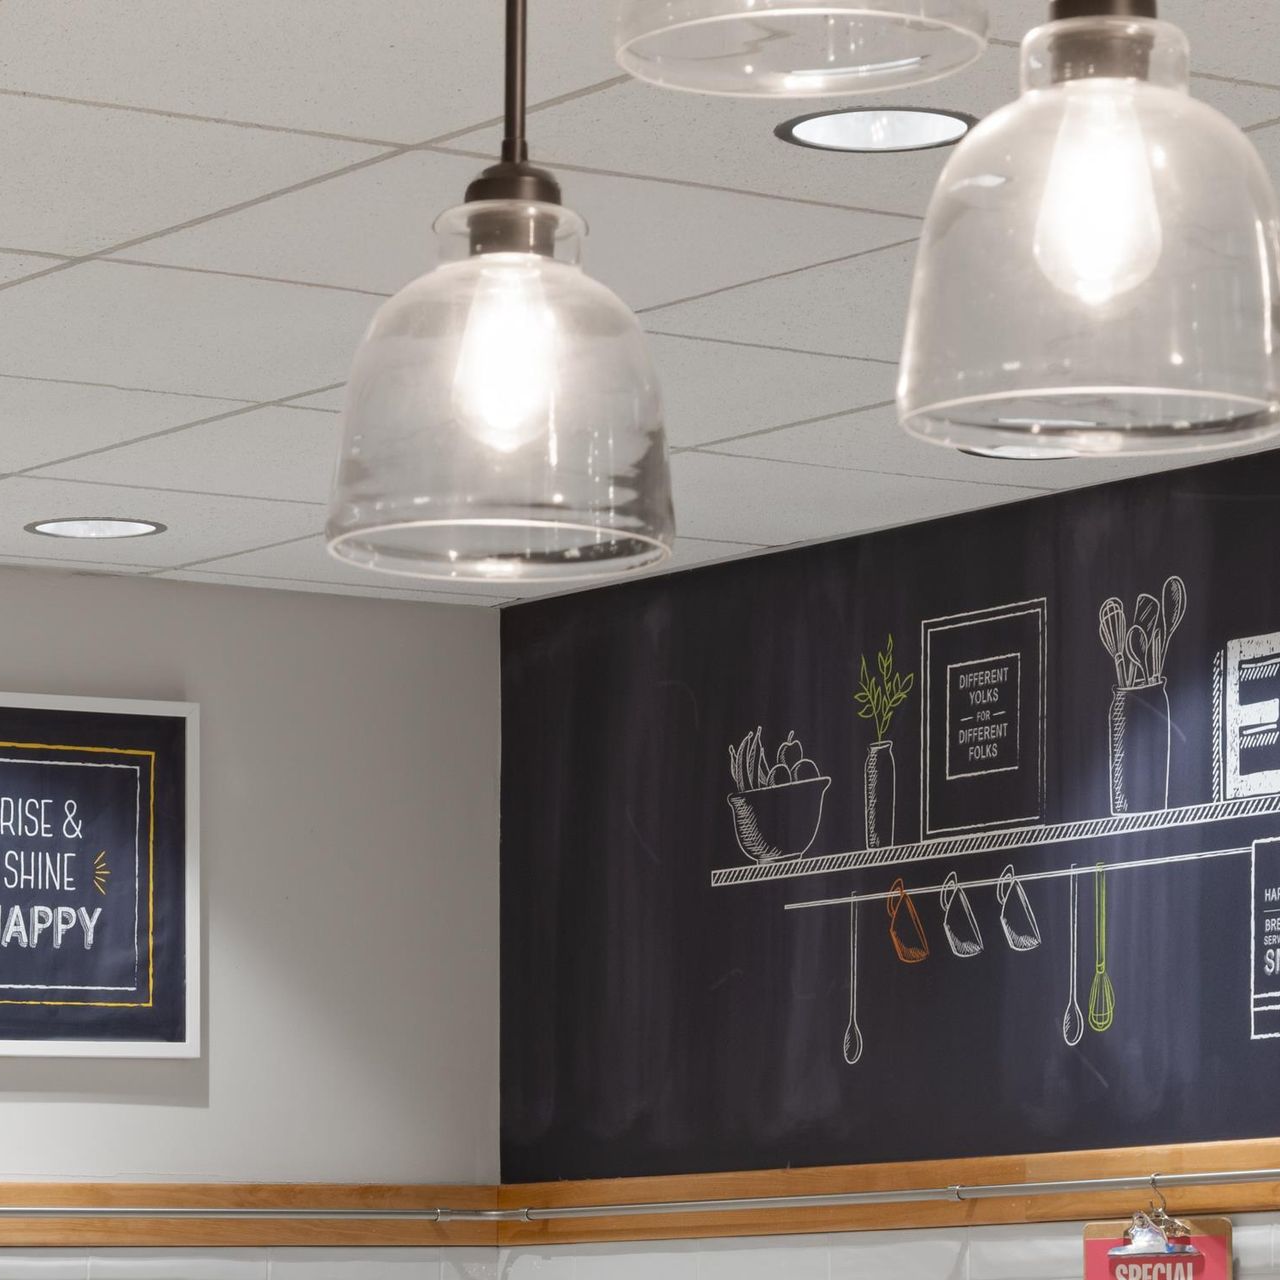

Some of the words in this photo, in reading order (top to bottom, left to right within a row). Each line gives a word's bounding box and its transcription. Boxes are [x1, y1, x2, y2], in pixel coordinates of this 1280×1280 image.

[959, 667, 1009, 688] DIFFERENT
[969, 688, 999, 706] YOLKS
[976, 710, 990, 722] FOR
[958, 723, 1009, 744] DIFFERENT
[968, 743, 998, 761] FOLKS
[0, 796, 53, 838] RISE
[62, 799, 83, 838] &
[4, 850, 76, 891] SHINE
